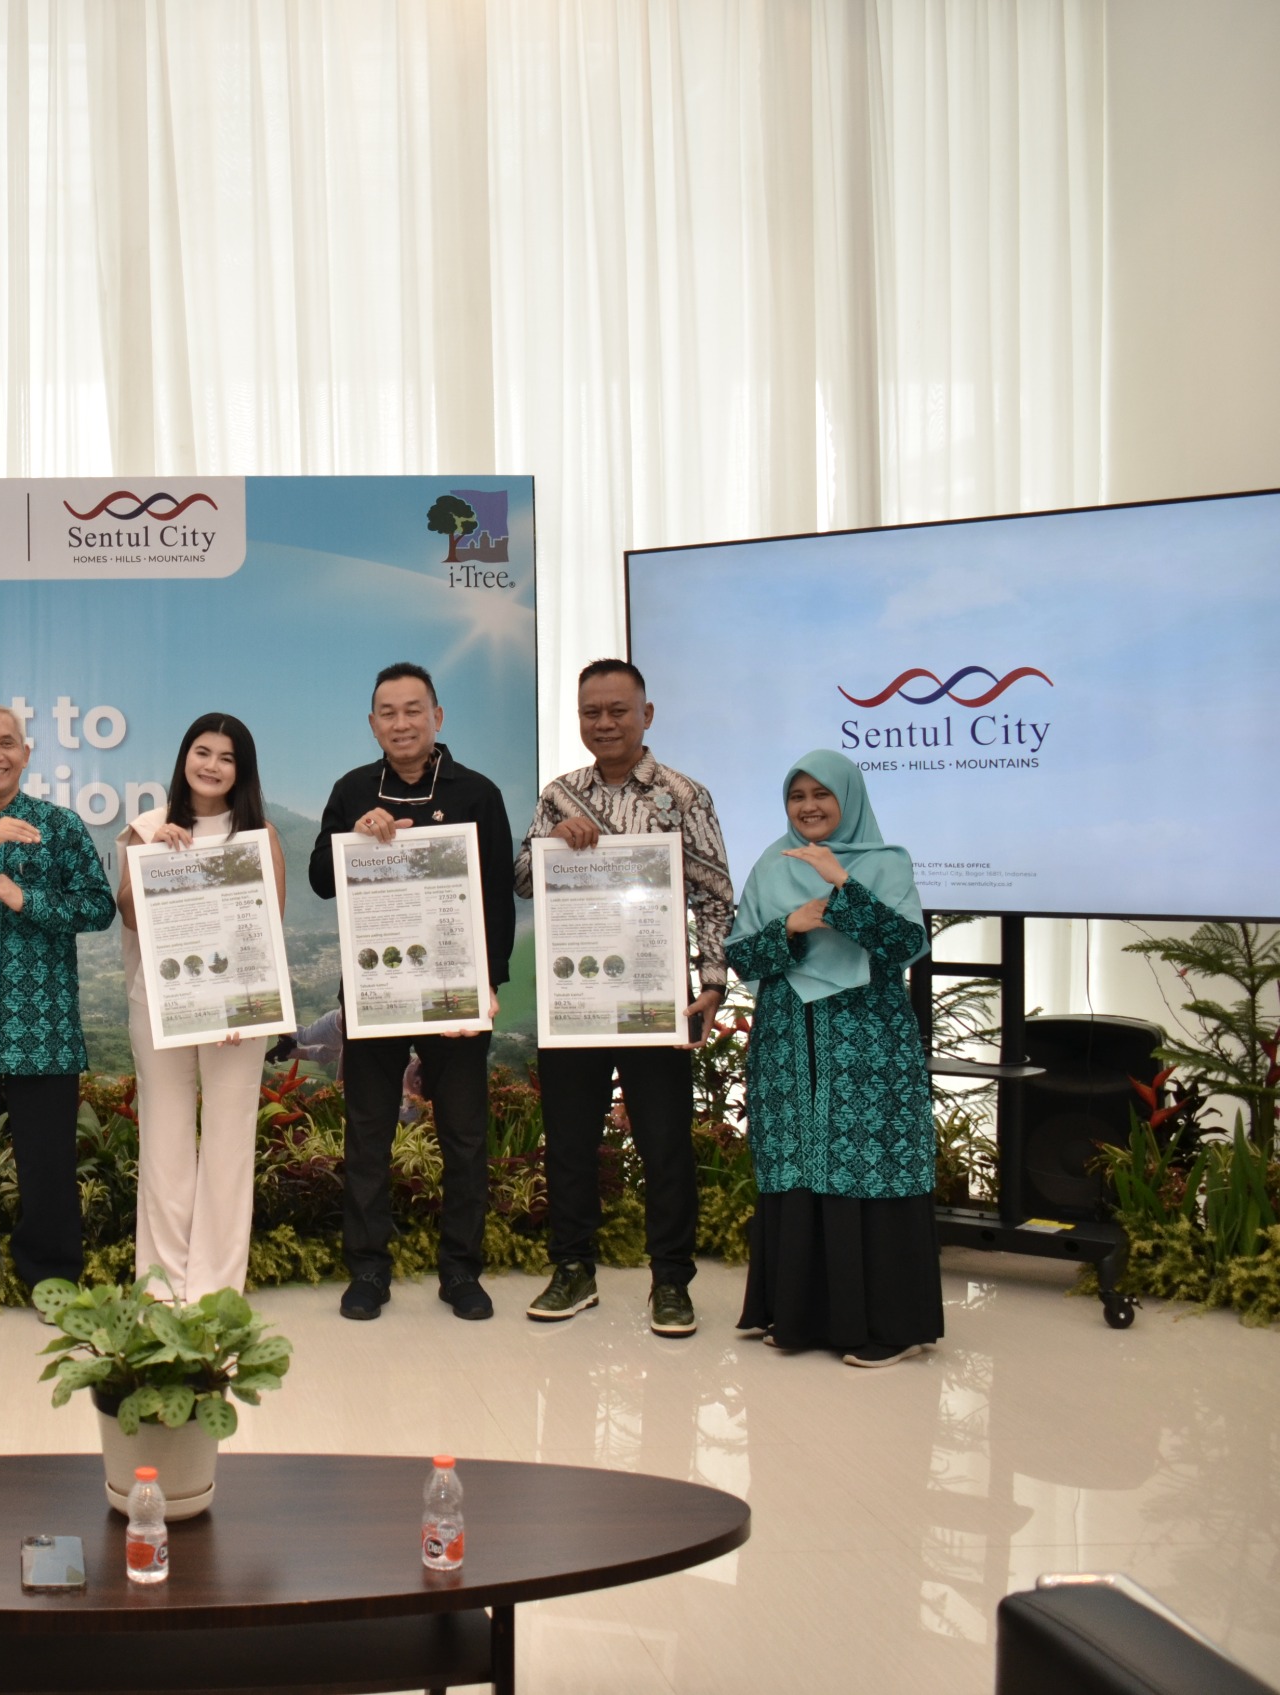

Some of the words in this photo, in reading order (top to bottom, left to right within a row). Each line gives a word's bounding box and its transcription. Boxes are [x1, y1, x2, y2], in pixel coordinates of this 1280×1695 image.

[69, 526, 150, 548] Sentul
[160, 525, 216, 552] City
[148, 554, 205, 562] MOUNTAINS
[52, 696, 126, 749] to
[841, 716, 954, 749] Sentul
[970, 714, 1051, 752] City
[909, 760, 945, 770] HILLS
[956, 758, 1039, 769] MOUNTAINS
[351, 856, 385, 868] Cluster
[387, 855, 409, 864] BGH
[552, 864, 588, 874] Cluster
[590, 861, 643, 872] Northridge
[150, 868, 184, 878] Cluster
[185, 864, 202, 874] R21
